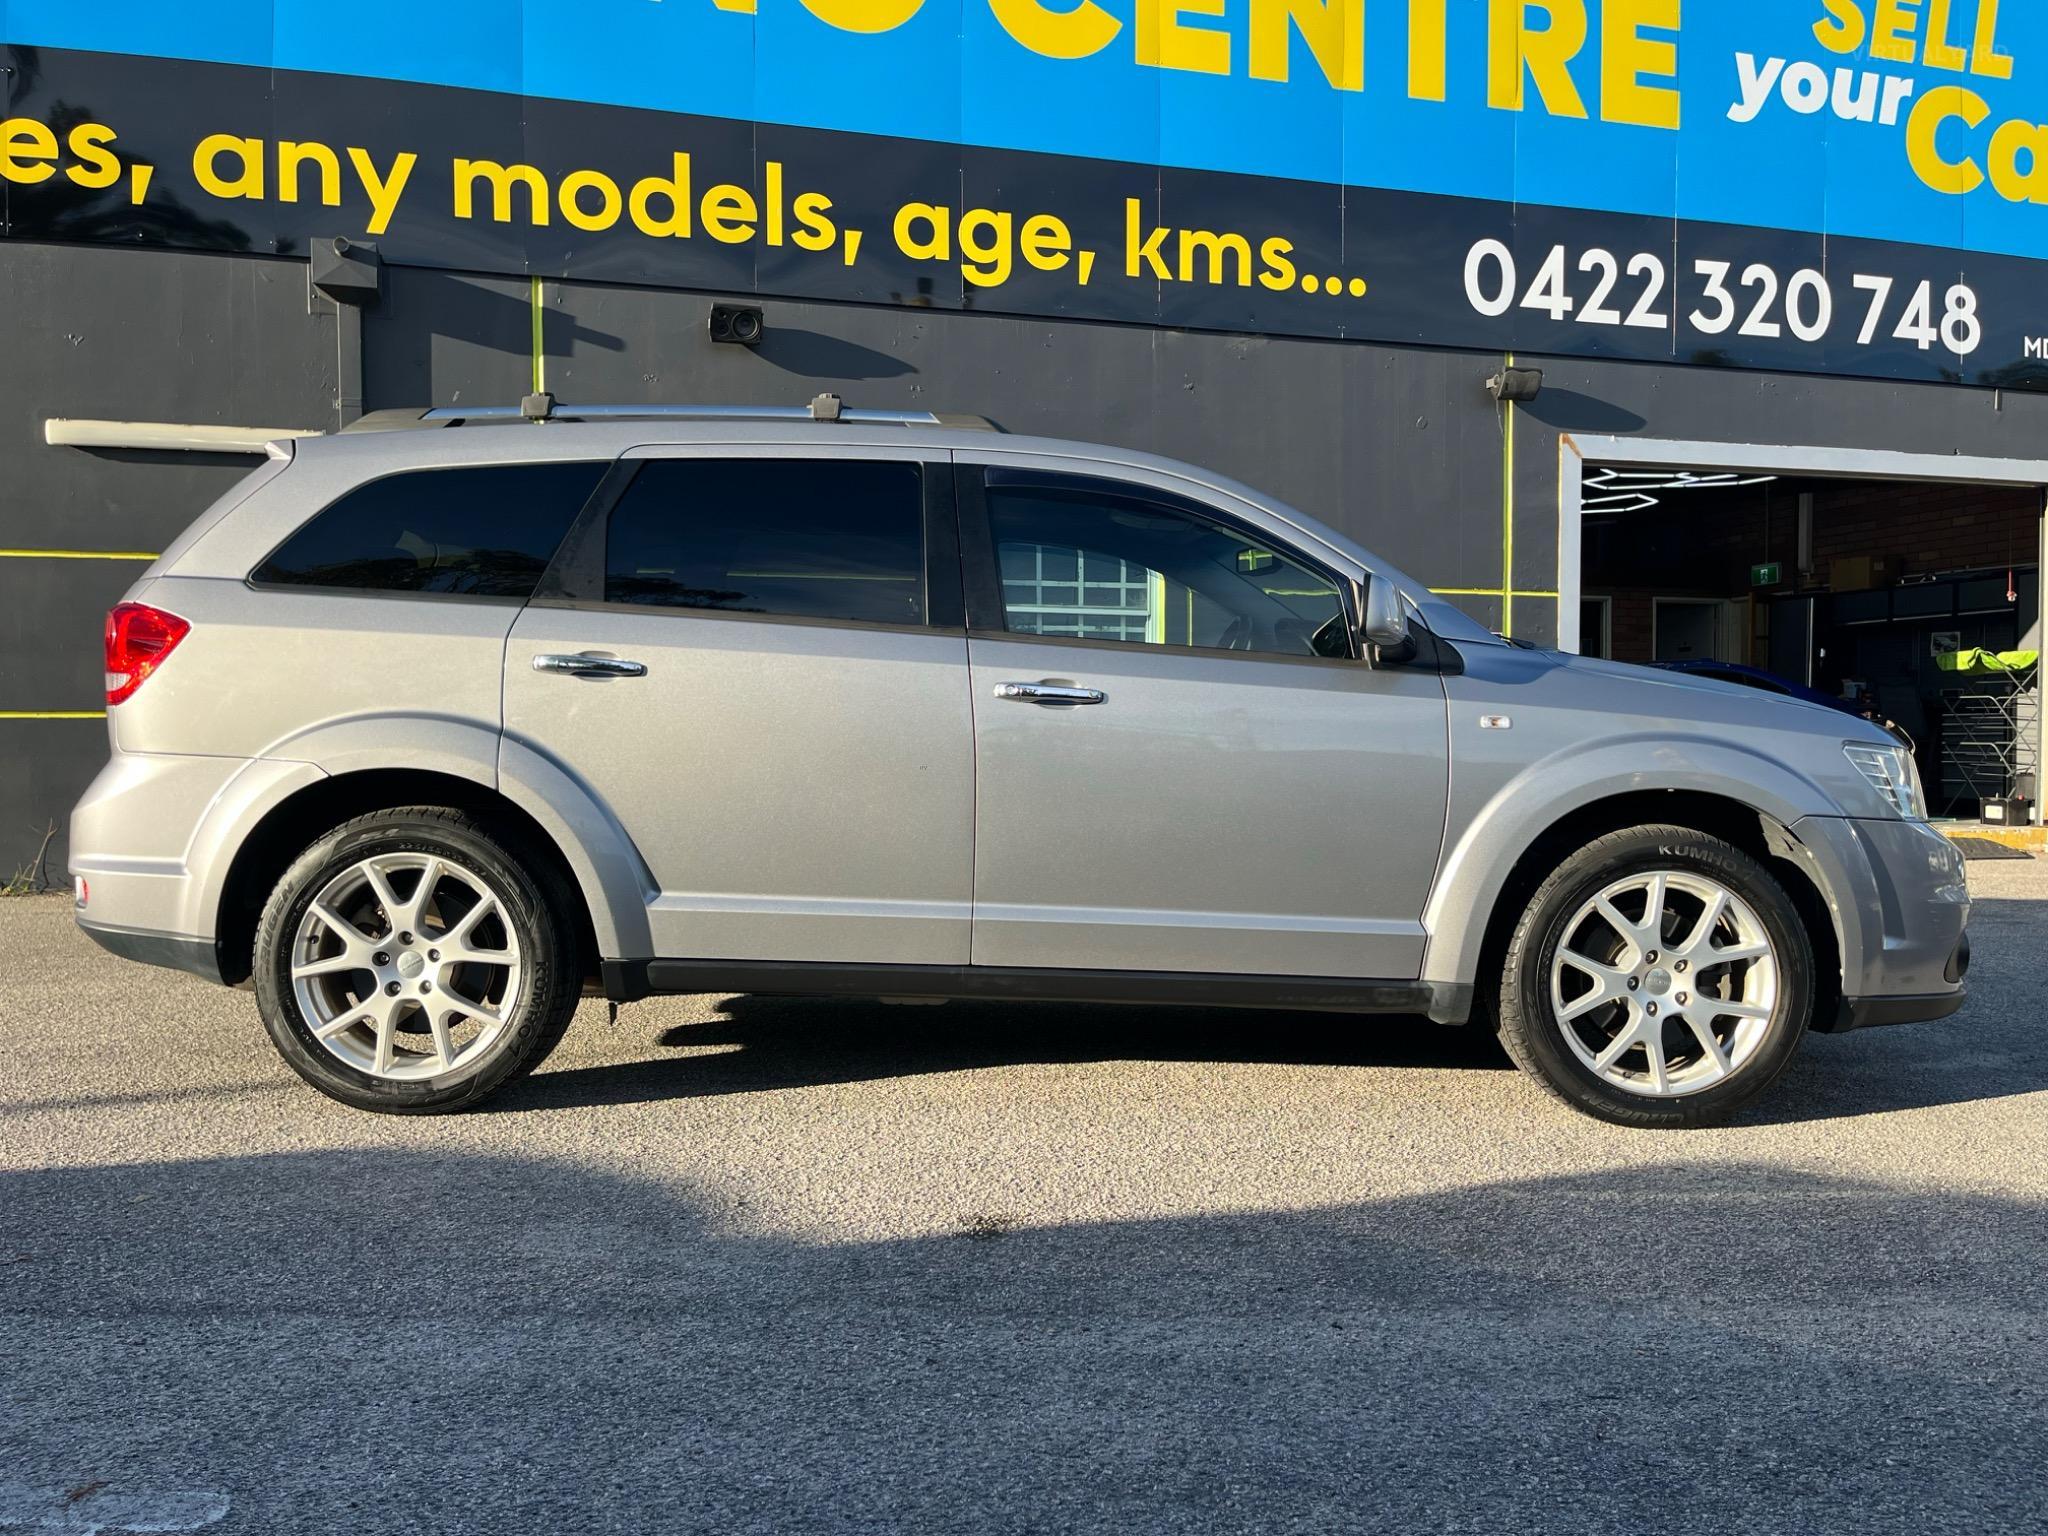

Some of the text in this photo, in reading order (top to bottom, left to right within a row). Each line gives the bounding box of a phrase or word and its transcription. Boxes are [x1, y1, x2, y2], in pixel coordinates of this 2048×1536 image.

[1812, 0, 2013, 79] SELL
[1726, 52, 2048, 205] your Ca
[0, 117, 1367, 297] es, any models, age, kms...
[1464, 238, 1981, 356] 0422 320 748
[1658, 844, 1738, 872] KUMHO
